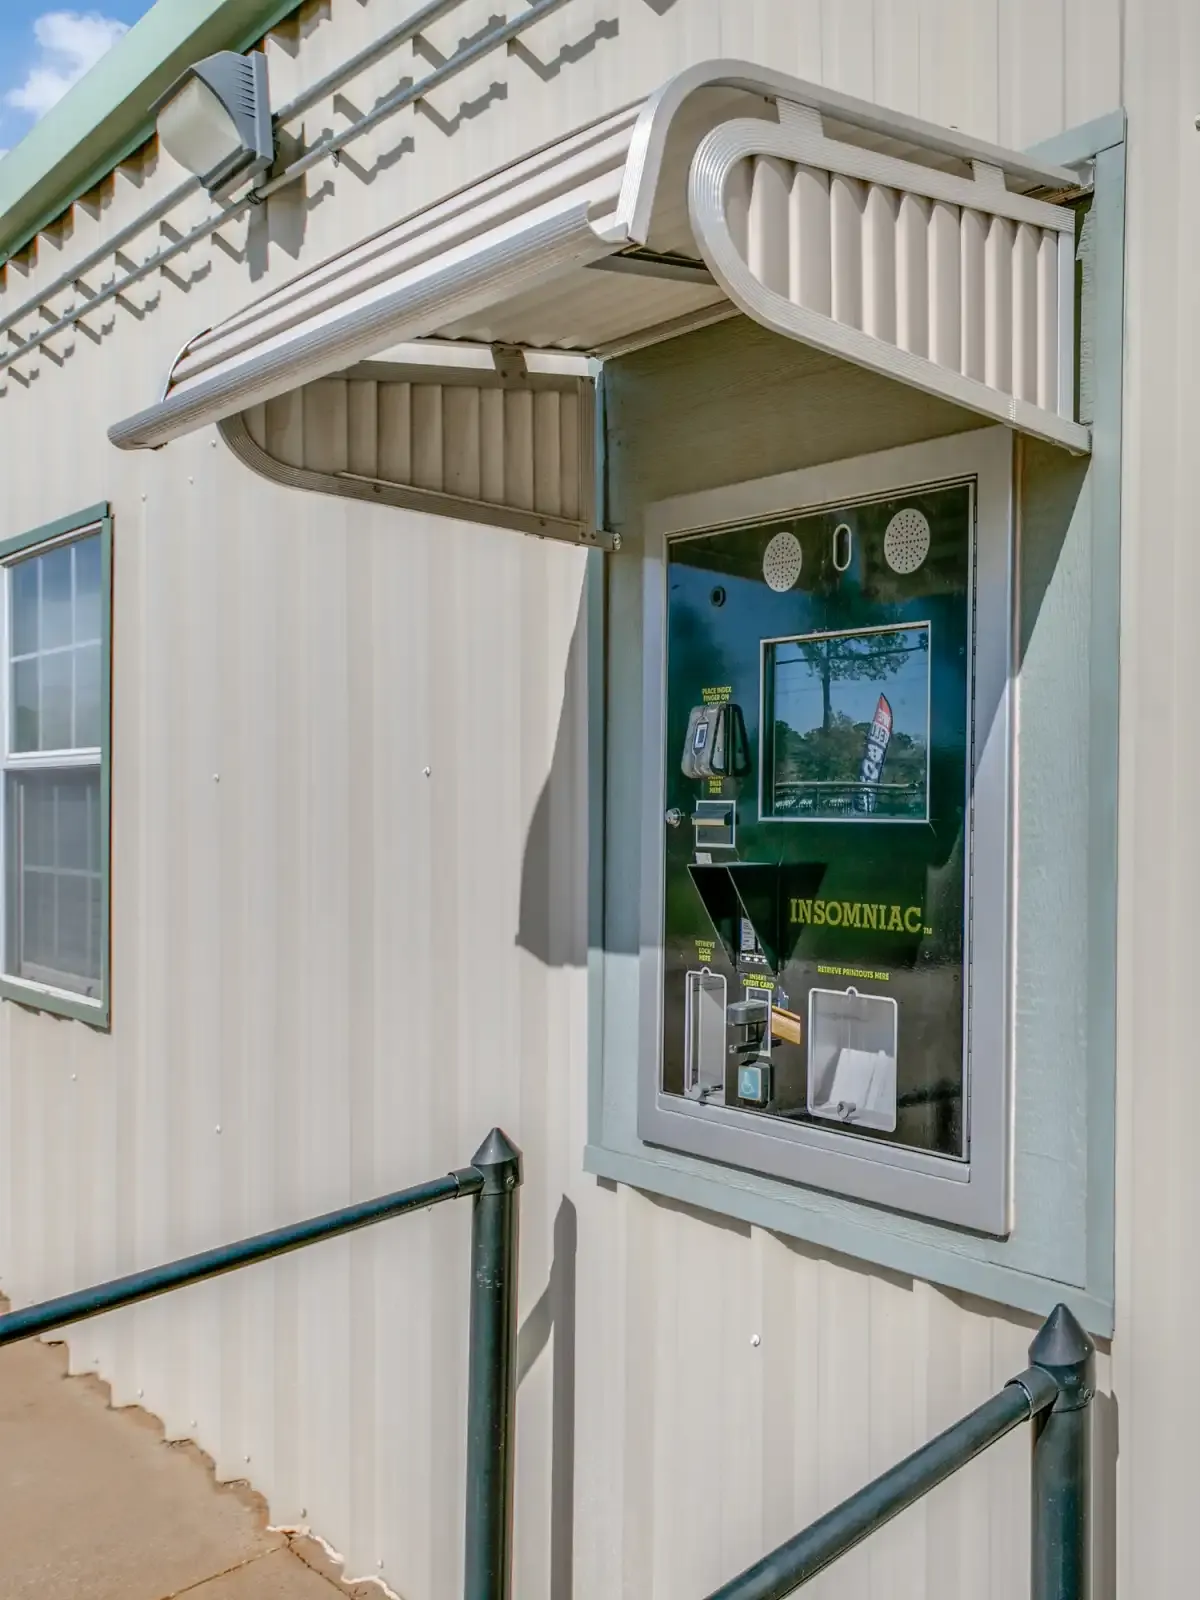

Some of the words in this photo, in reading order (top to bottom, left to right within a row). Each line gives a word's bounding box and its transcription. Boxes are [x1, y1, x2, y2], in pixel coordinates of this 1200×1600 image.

[790, 898, 922, 933] INSOMNIAC
[817, 965, 842, 975] RETRIEVE
[842, 967, 874, 979] PRINTOUTS
[874, 971, 889, 981] HERE
[759, 981, 775, 989] CARD
